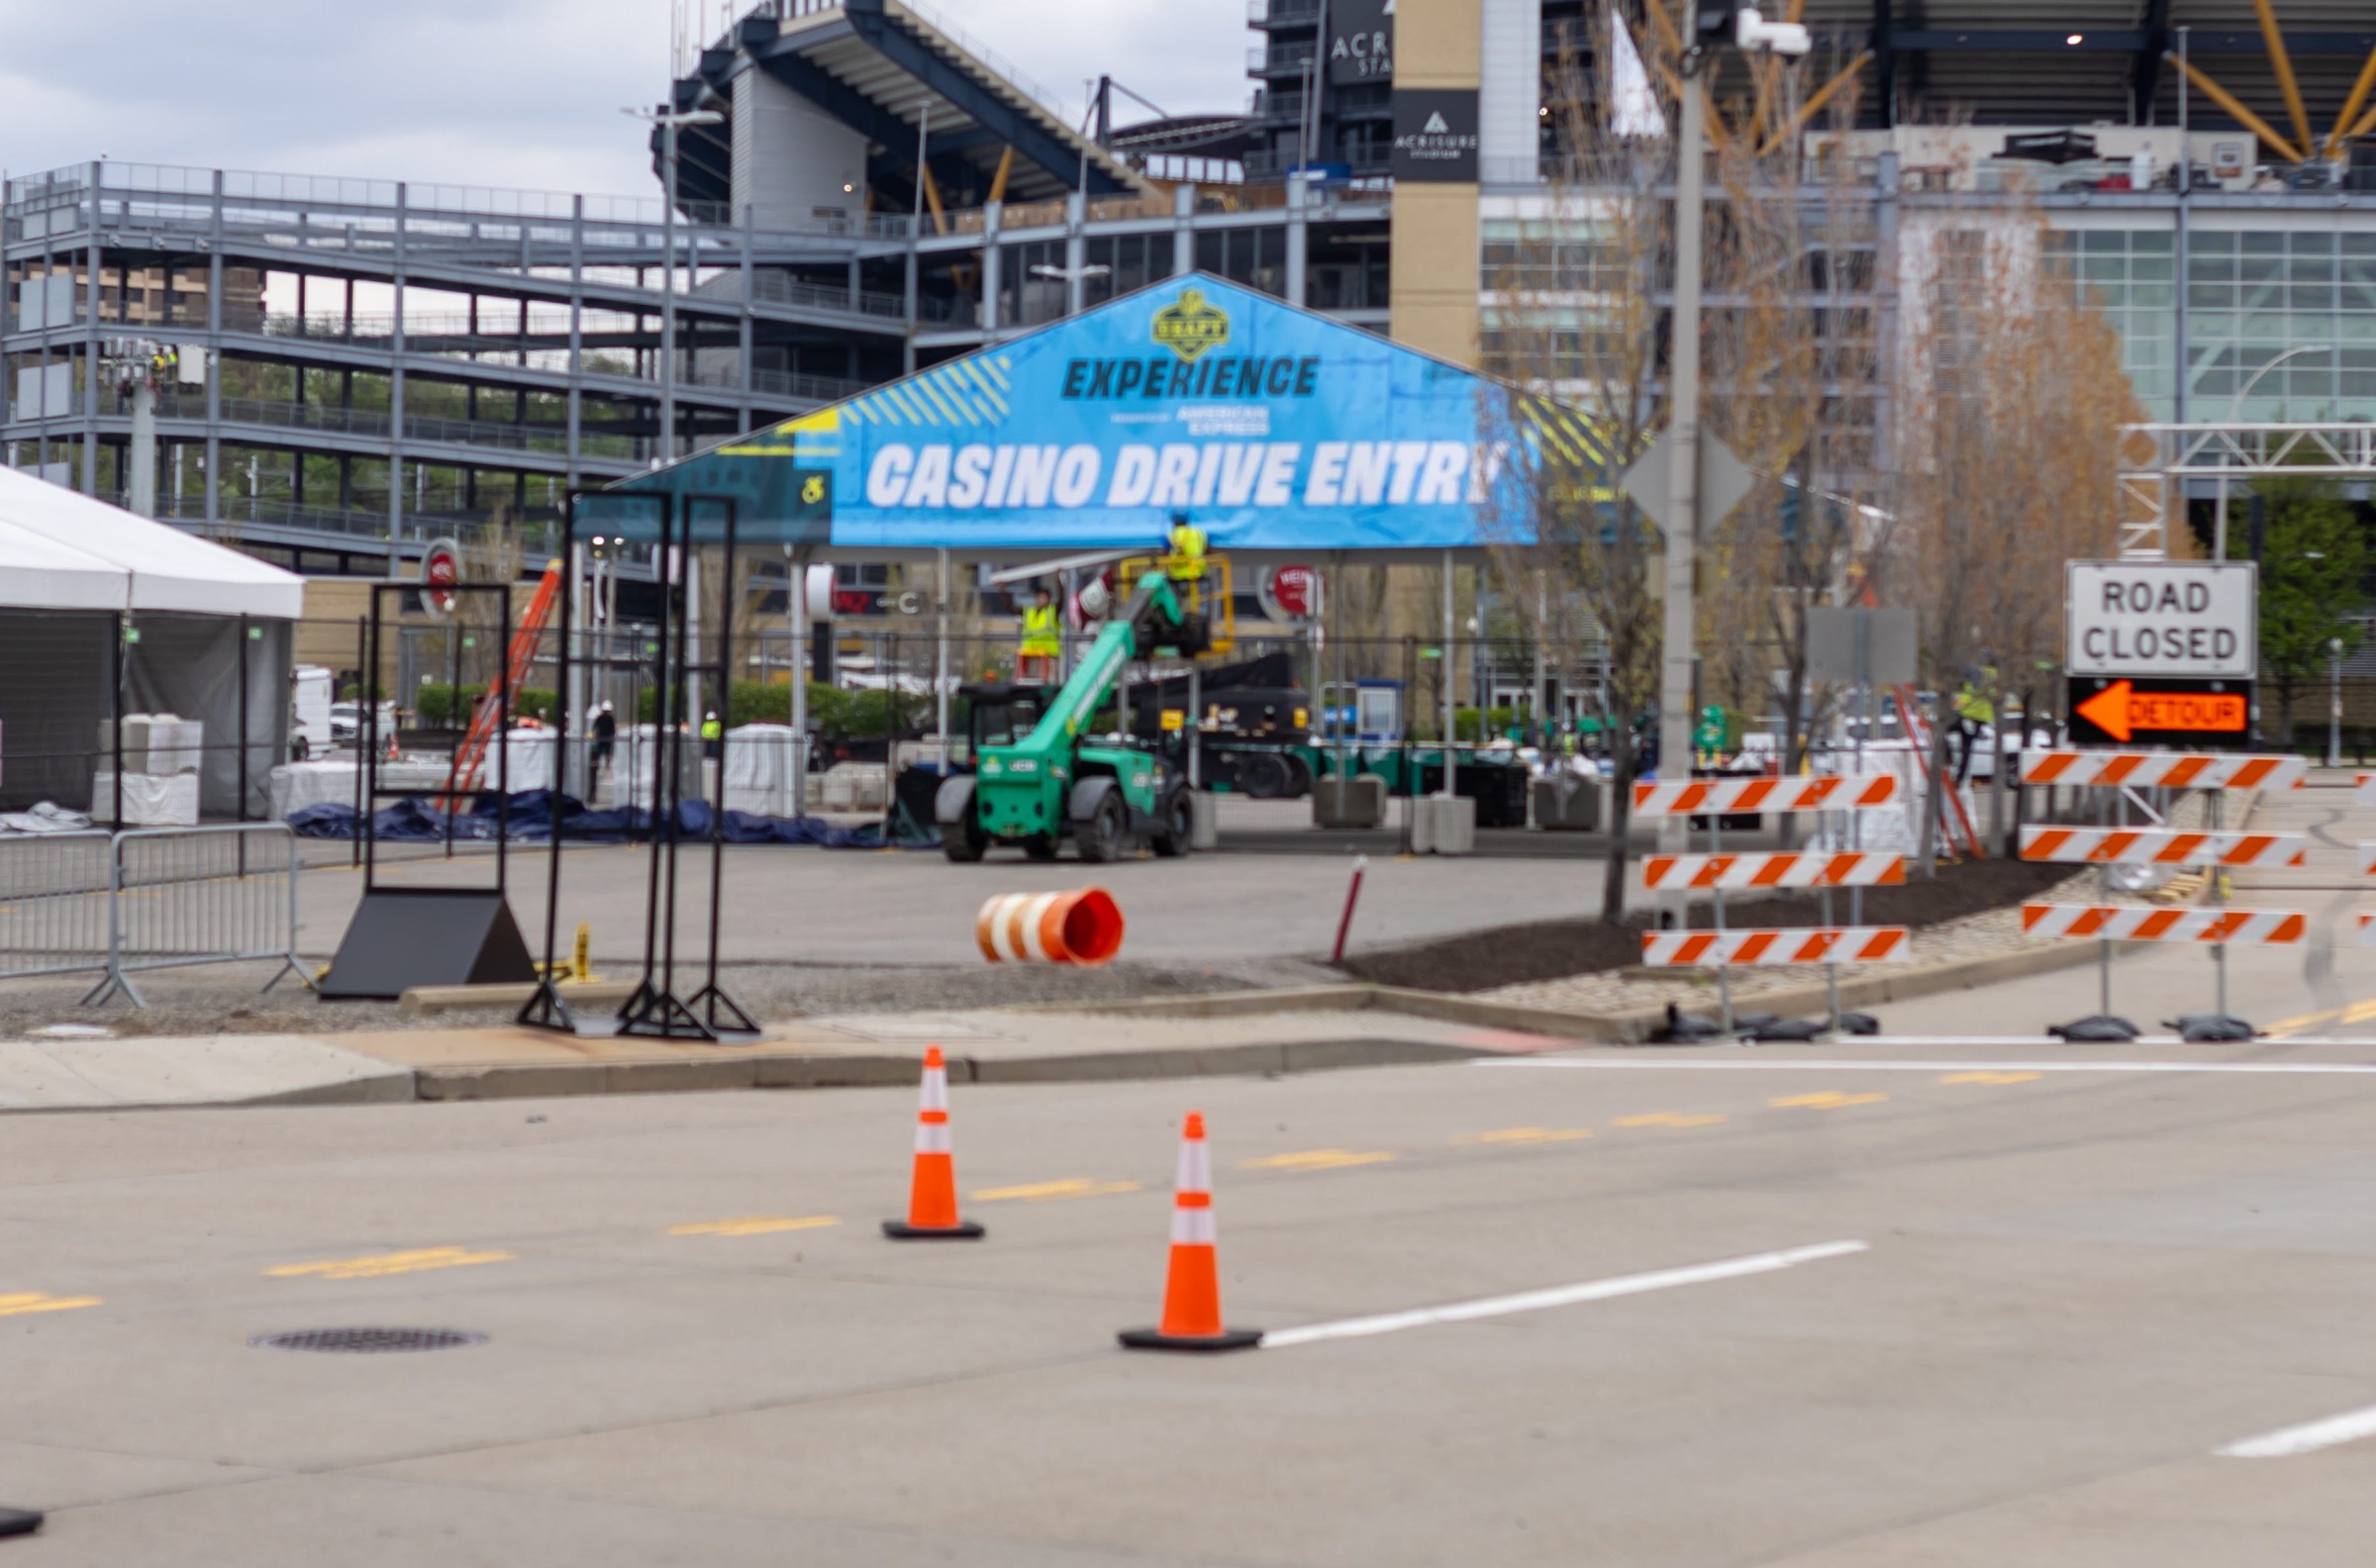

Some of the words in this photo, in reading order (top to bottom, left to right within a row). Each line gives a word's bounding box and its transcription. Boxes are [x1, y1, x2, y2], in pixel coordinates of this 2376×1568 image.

[1331, 32, 1389, 59] ACR
[1358, 56, 1393, 76] STA
[1394, 135, 1478, 148] ACRISURE
[1061, 356, 1320, 399] EXPERIENCE
[1176, 406, 1269, 421] AMERICAN
[1189, 422, 1270, 436] EXPRESS
[866, 442, 1101, 508] CASINO
[1107, 442, 1300, 507] DRIVE
[2102, 581, 2210, 614] ROAD
[2083, 627, 2237, 660] CLOSED
[2129, 700, 2235, 725] DETOUR
